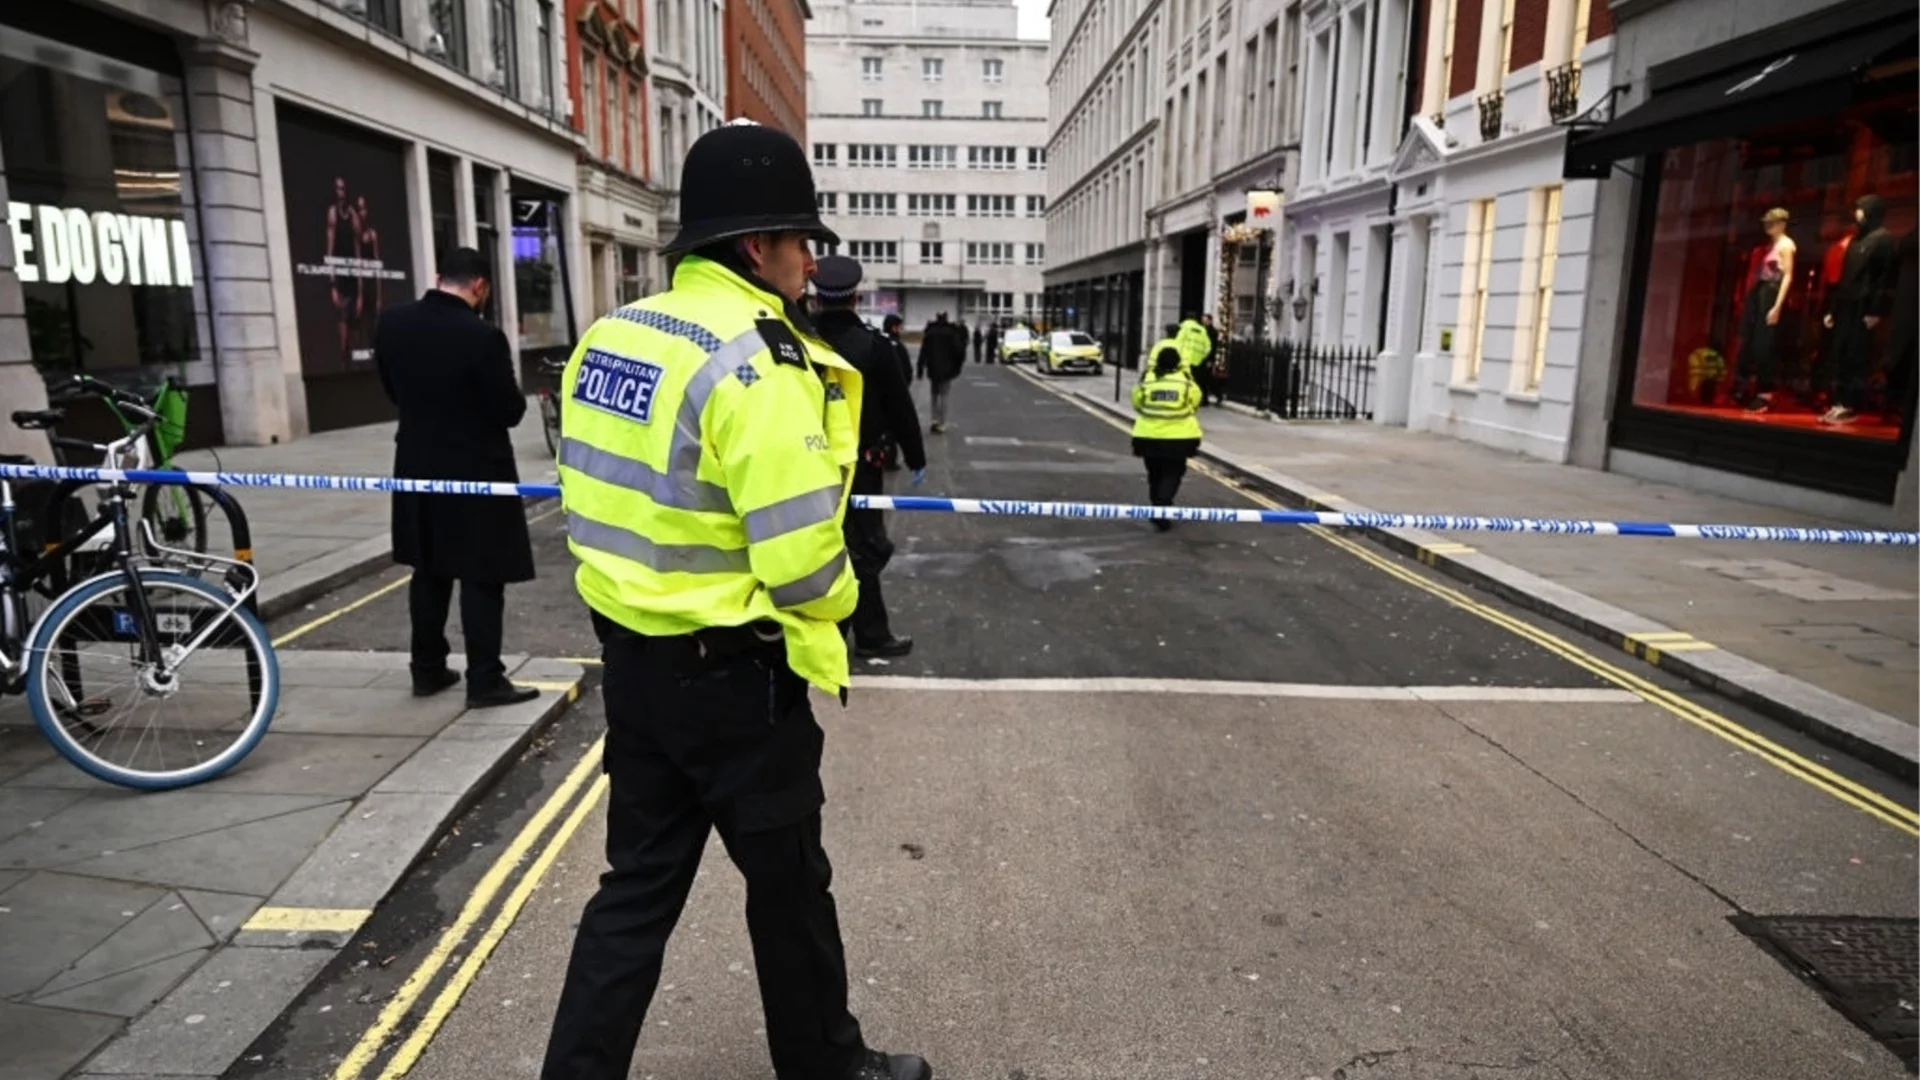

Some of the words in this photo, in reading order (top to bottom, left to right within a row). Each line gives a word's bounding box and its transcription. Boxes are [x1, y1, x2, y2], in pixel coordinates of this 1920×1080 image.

[38, 204, 97, 285] DO
[92, 211, 173, 286] GYM
[574, 365, 652, 416] POLICE
